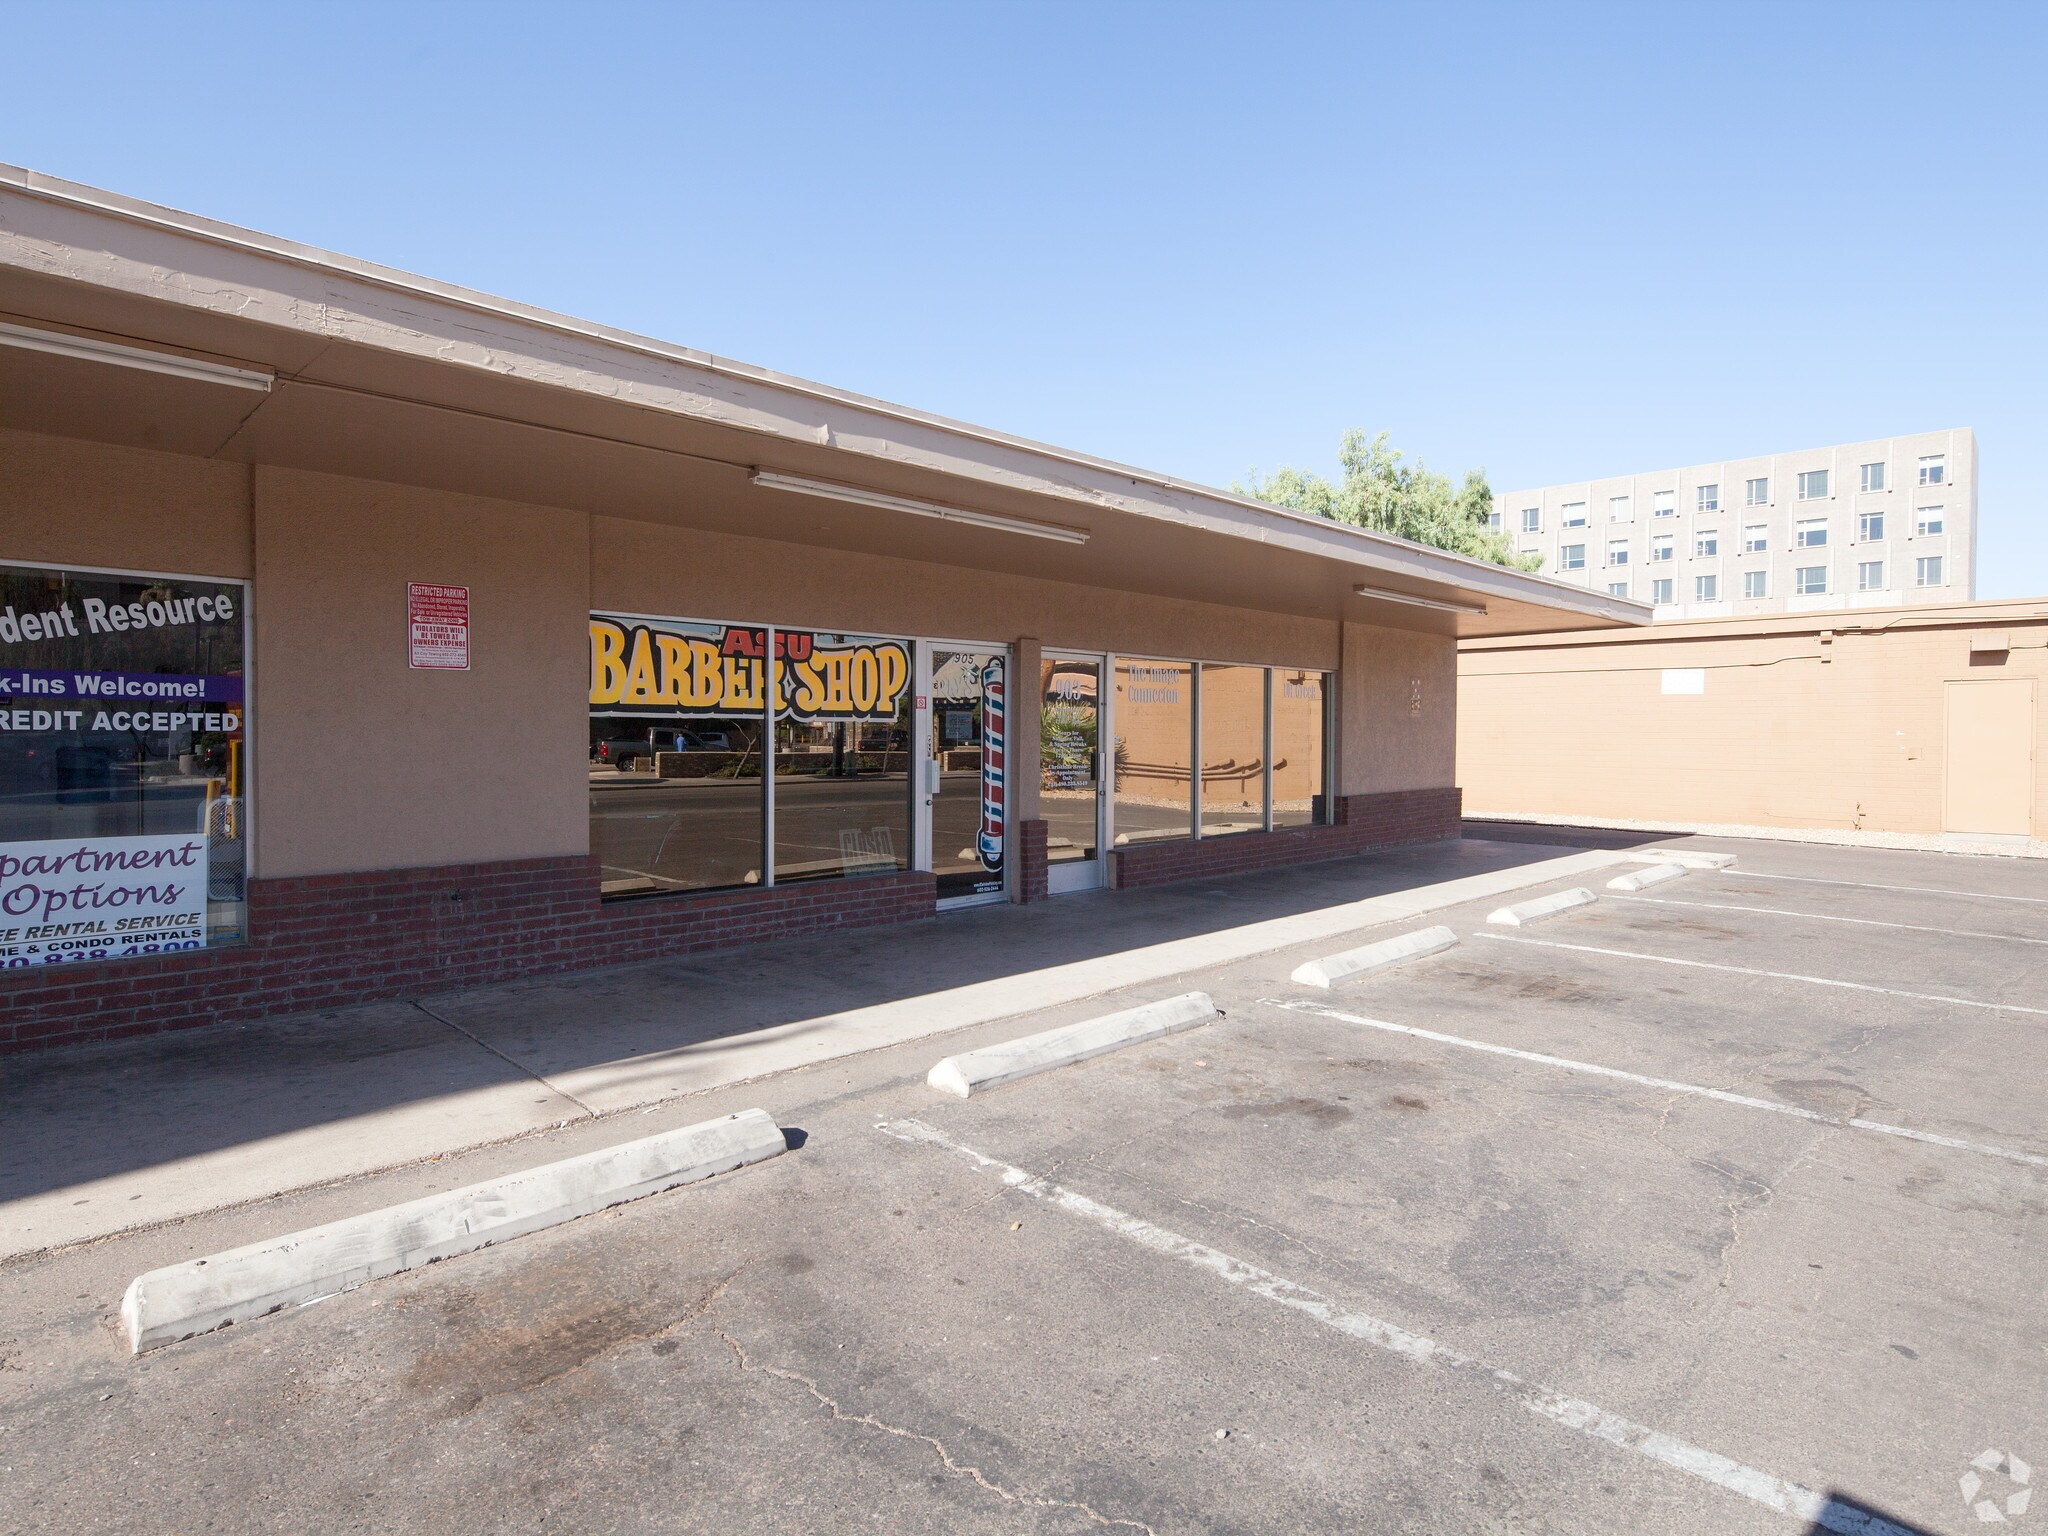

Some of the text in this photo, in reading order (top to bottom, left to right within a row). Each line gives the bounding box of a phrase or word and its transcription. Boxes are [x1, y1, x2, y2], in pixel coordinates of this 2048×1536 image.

[411, 585, 466, 599] RESTRICTED PARKING
[0, 594, 234, 644] dent Resource
[415, 625, 448, 633] VIOLATORS
[722, 629, 812, 661] ASU
[954, 653, 975, 665] 905
[74, 675, 206, 698] Welcome!
[793, 643, 907, 713] SHOP
[1127, 666, 1180, 685] The Image
[1056, 679, 1081, 700] 903
[91, 711, 239, 732] ACCEPTED
[0, 842, 202, 888] partment
[2, 882, 186, 922] Options
[24, 920, 107, 940] RENTAL
[114, 912, 201, 931] SERVICE
[27, 944, 40, 954] &
[47, 937, 115, 951] CONDO
[121, 929, 202, 944] RENTALS
